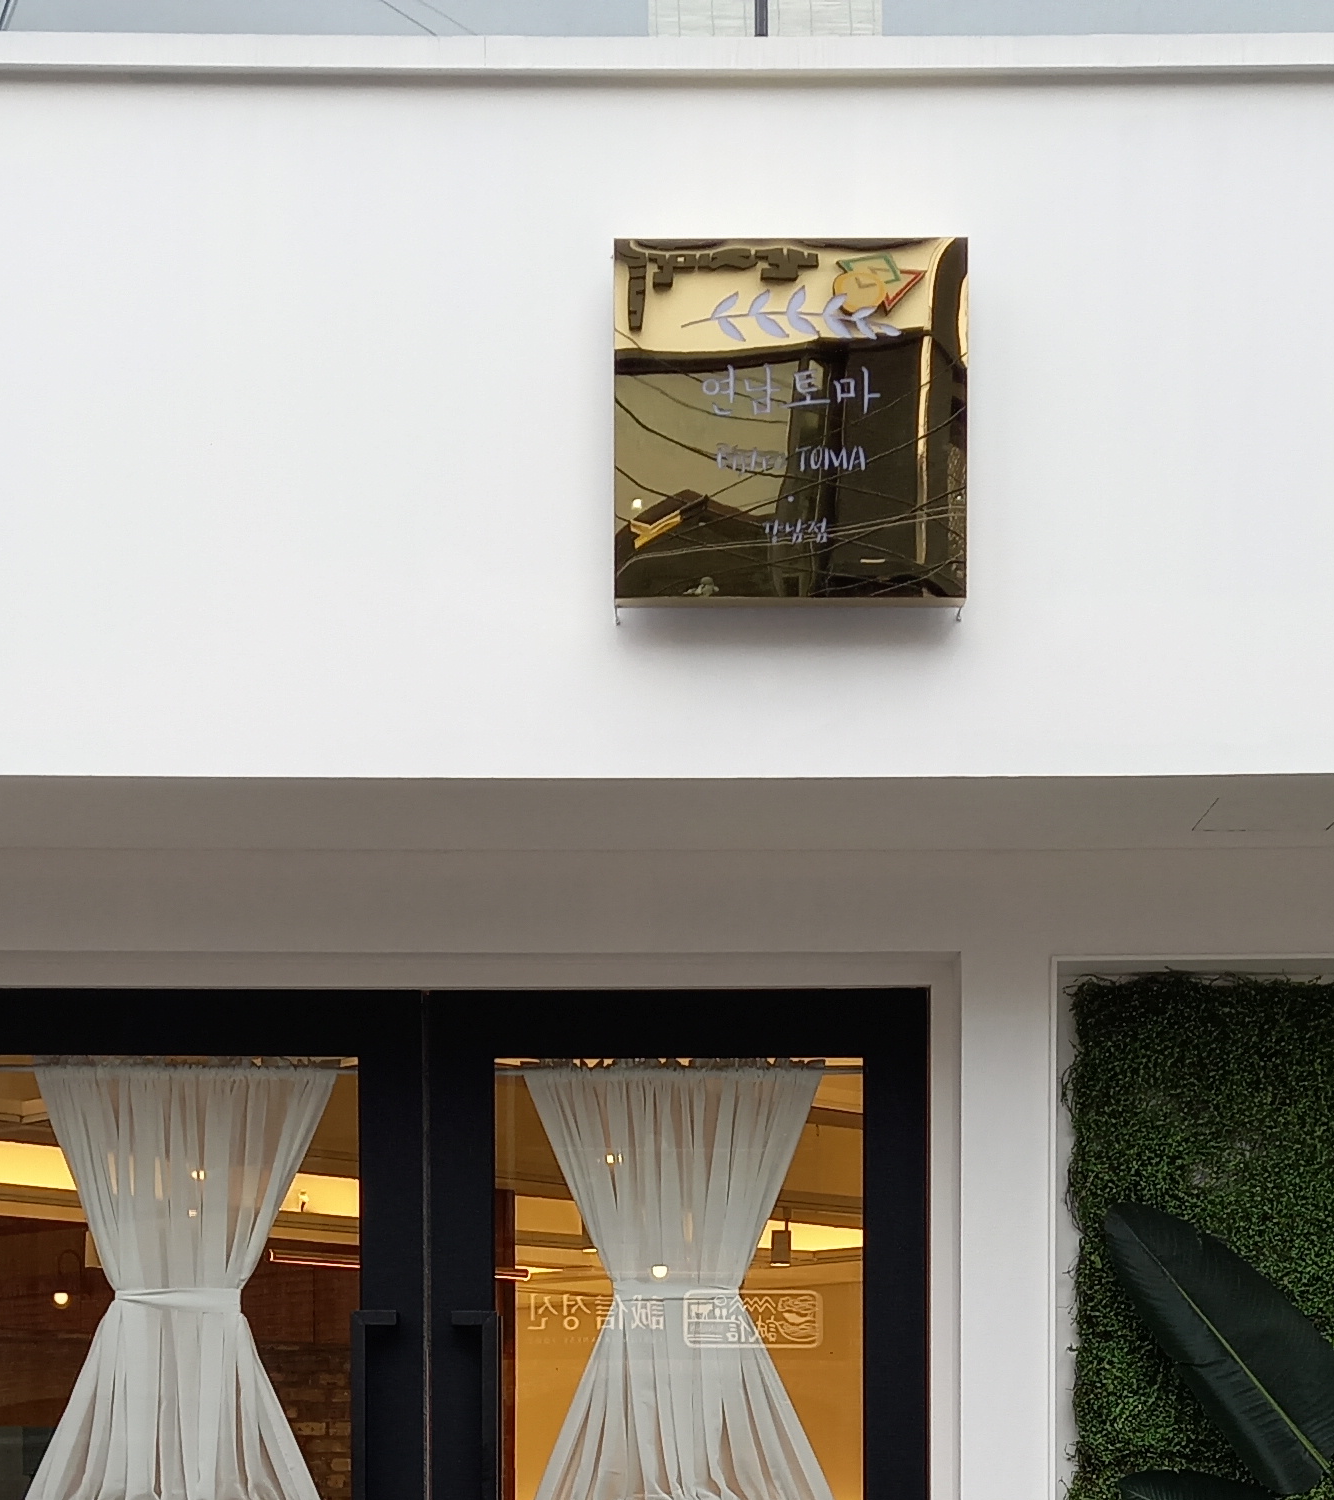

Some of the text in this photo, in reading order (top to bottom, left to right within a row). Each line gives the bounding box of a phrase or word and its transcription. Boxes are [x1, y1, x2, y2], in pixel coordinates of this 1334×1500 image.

[702, 364, 880, 415] 연남토마
[796, 445, 867, 472] TOMA
[763, 518, 828, 545] 강남점
